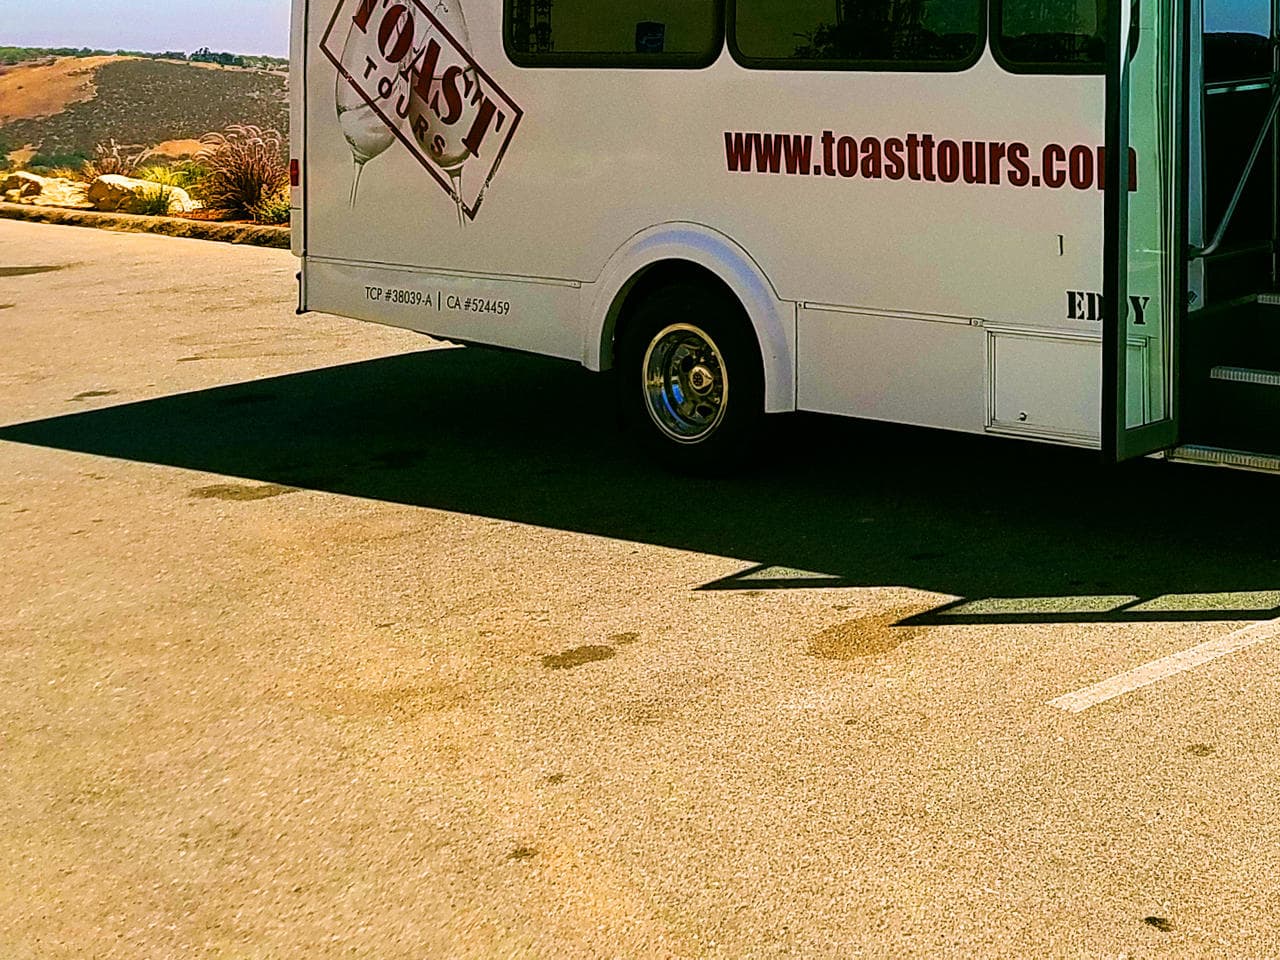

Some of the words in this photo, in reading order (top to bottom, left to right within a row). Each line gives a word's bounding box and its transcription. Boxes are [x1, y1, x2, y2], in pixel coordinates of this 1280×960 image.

[363, 55, 446, 156] TOURS
[365, 286, 382, 301] TCP
[384, 289, 432, 307] #38039-A
[446, 295, 461, 310] CA
[464, 298, 510, 316] #524459
[1066, 290, 1150, 325] EDY
